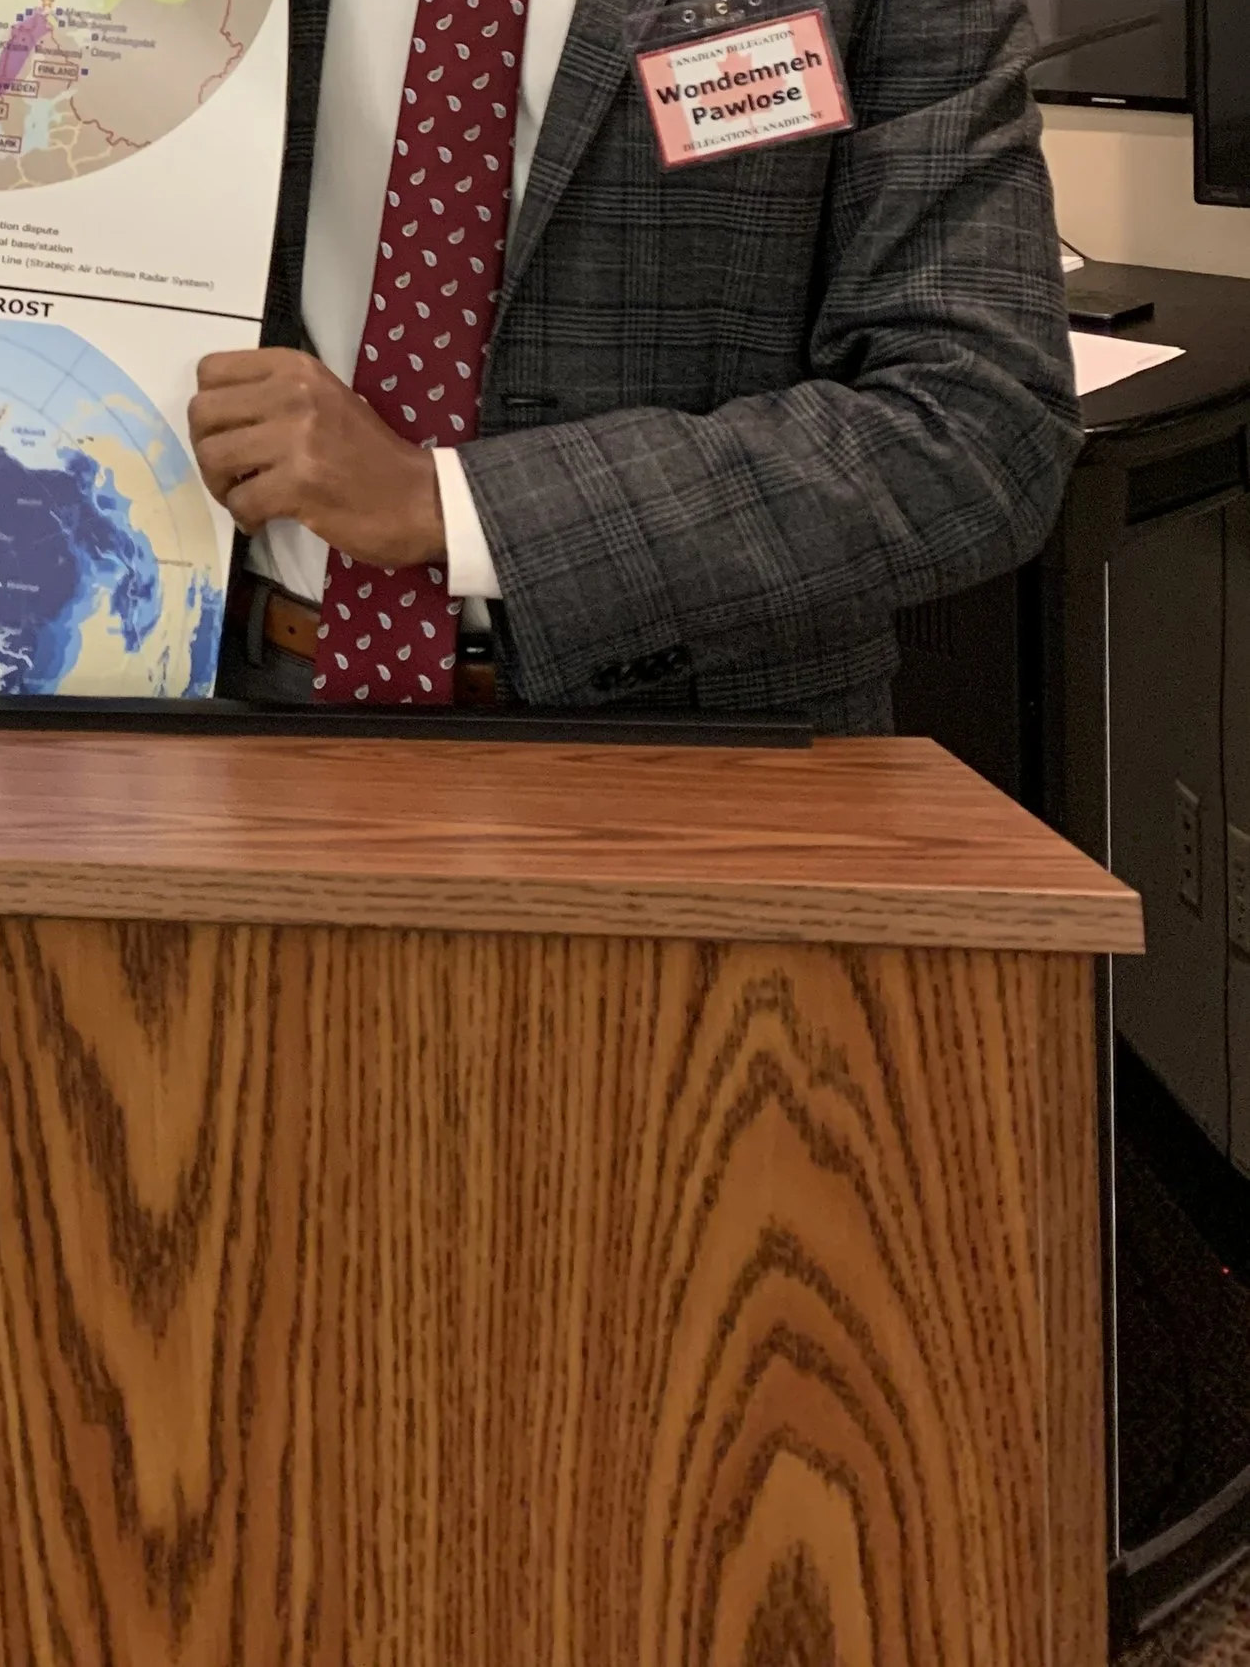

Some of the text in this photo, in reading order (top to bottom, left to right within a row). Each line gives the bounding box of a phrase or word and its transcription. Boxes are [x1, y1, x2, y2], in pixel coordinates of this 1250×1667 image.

[667, 29, 796, 69] CANADIAN DELEGATION
[38, 65, 77, 77] FINLAND
[656, 49, 823, 106] Wondemneh
[692, 86, 804, 125] Pawlose
[22, 223, 59, 236] dispute
[10, 239, 73, 254] base/station
[2, 255, 22, 266] Line
[25, 258, 75, 273] (Strategic
[78, 264, 92, 273] Air
[95, 267, 136, 279] Defense
[139, 271, 169, 283] Radar
